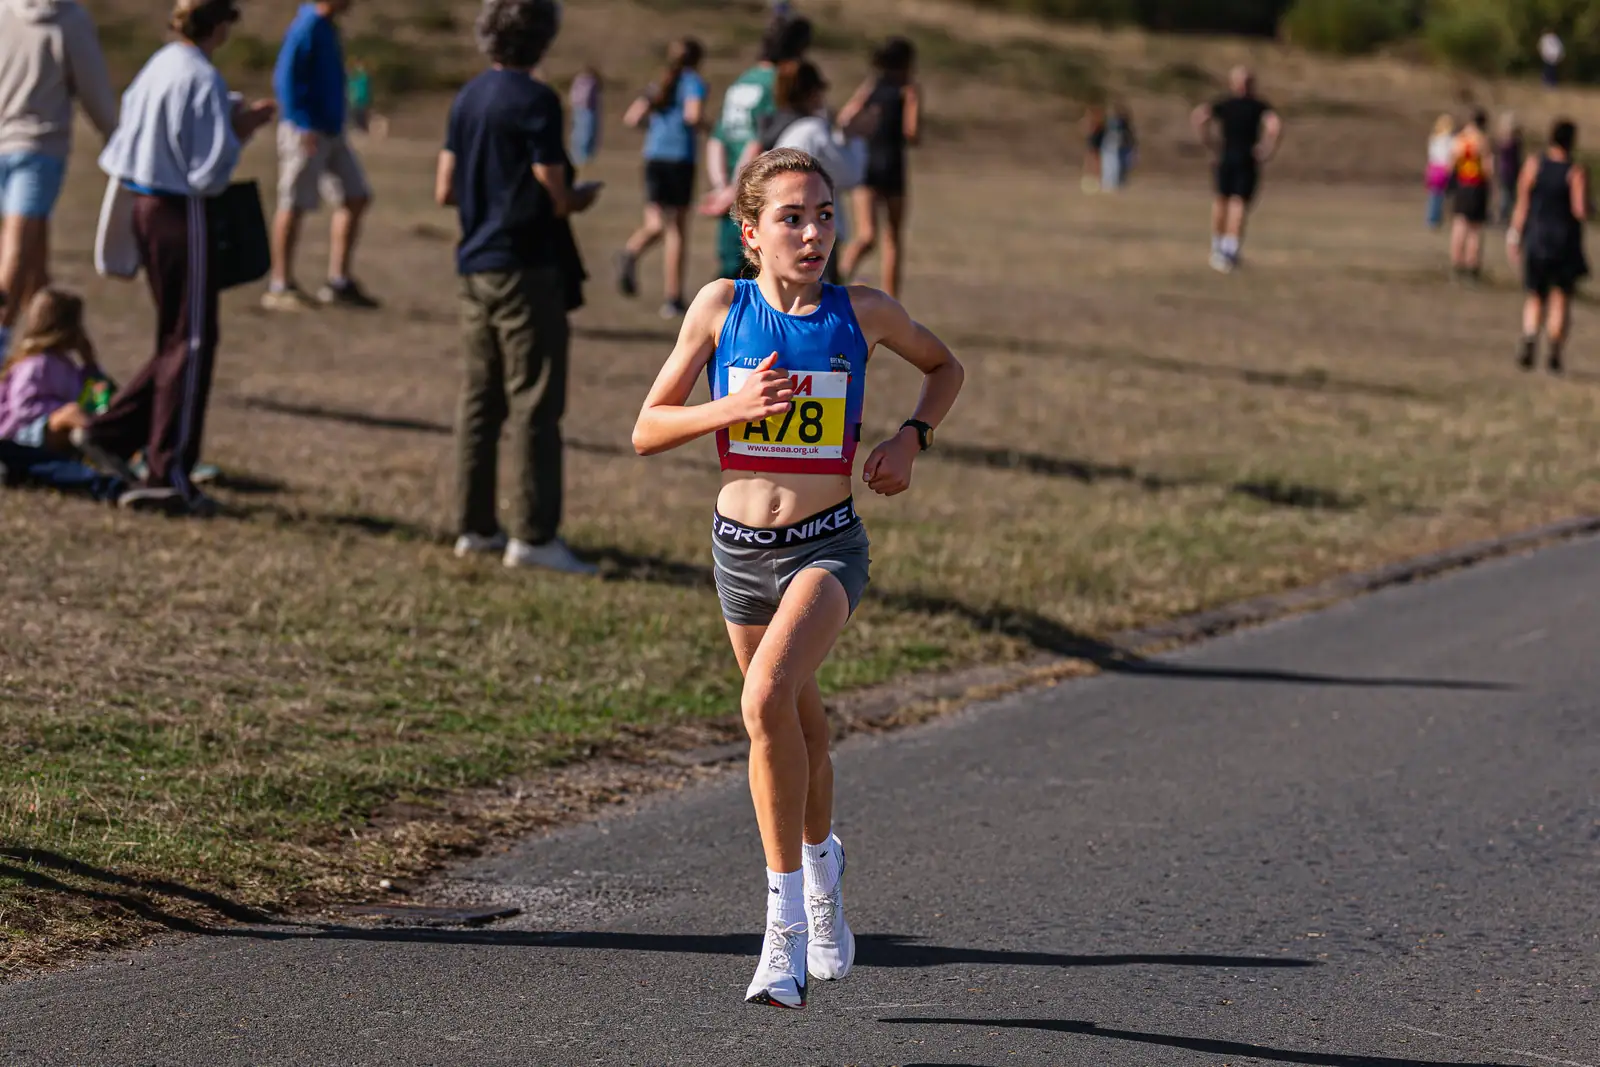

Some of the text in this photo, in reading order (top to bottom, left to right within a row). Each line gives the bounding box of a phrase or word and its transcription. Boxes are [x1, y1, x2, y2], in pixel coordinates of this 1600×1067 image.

[747, 443, 819, 455] www.seaa.org.uk
[718, 521, 777, 544] PRO
[785, 506, 850, 542] NIKE
